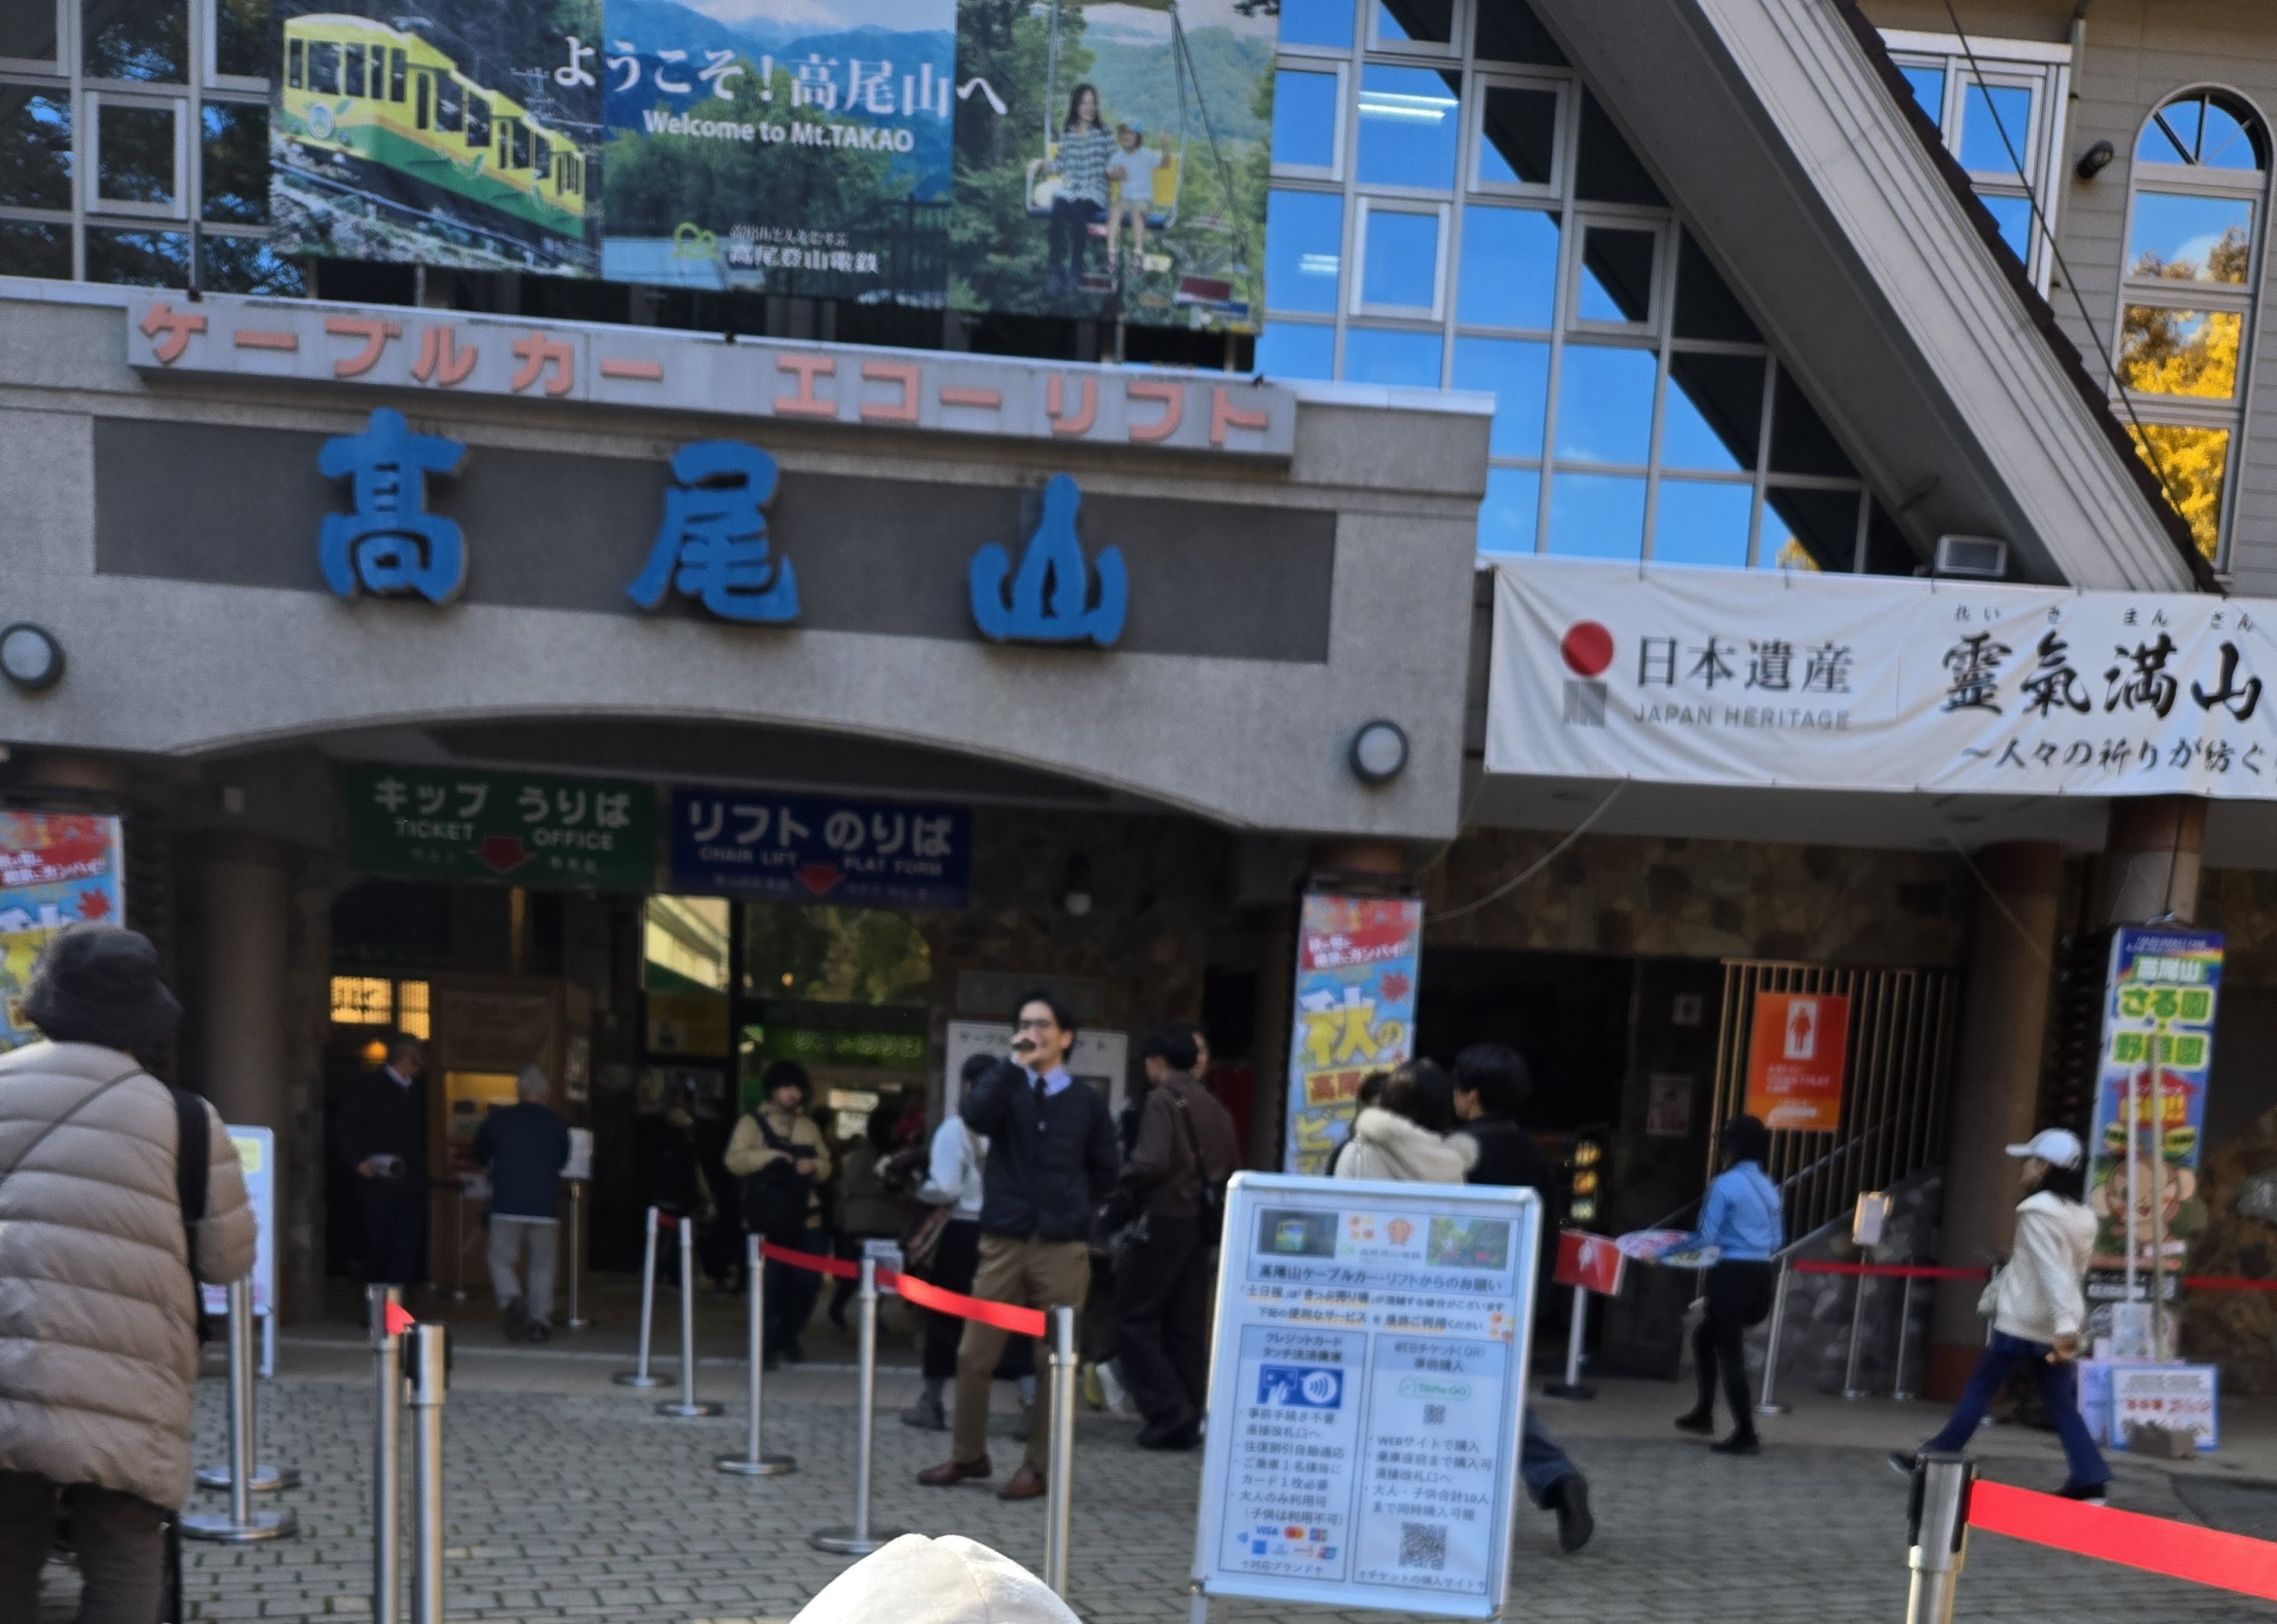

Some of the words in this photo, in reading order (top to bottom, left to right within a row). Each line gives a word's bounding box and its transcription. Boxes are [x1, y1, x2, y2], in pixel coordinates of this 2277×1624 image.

[643, 109, 756, 142] Welcome
[759, 118, 786, 143] to
[790, 124, 914, 153] Mt.TAKAO
[140, 303, 664, 399] ケーブルカー
[1636, 634, 1854, 694] 日本遺産
[1633, 702, 1713, 724] JAPAN
[1724, 704, 1850, 731] HERITAGE
[517, 785, 631, 829] うりば
[395, 817, 474, 841] TICKET
[533, 827, 614, 851] OFFICE
[689, 801, 810, 848] リフト
[824, 810, 953, 858] のりば
[698, 846, 754, 863] CHAIR
[762, 850, 797, 867] LIFT
[1265, 1332, 1343, 1348] クレジットカード
[1255, 1525, 1279, 1537] VISA
